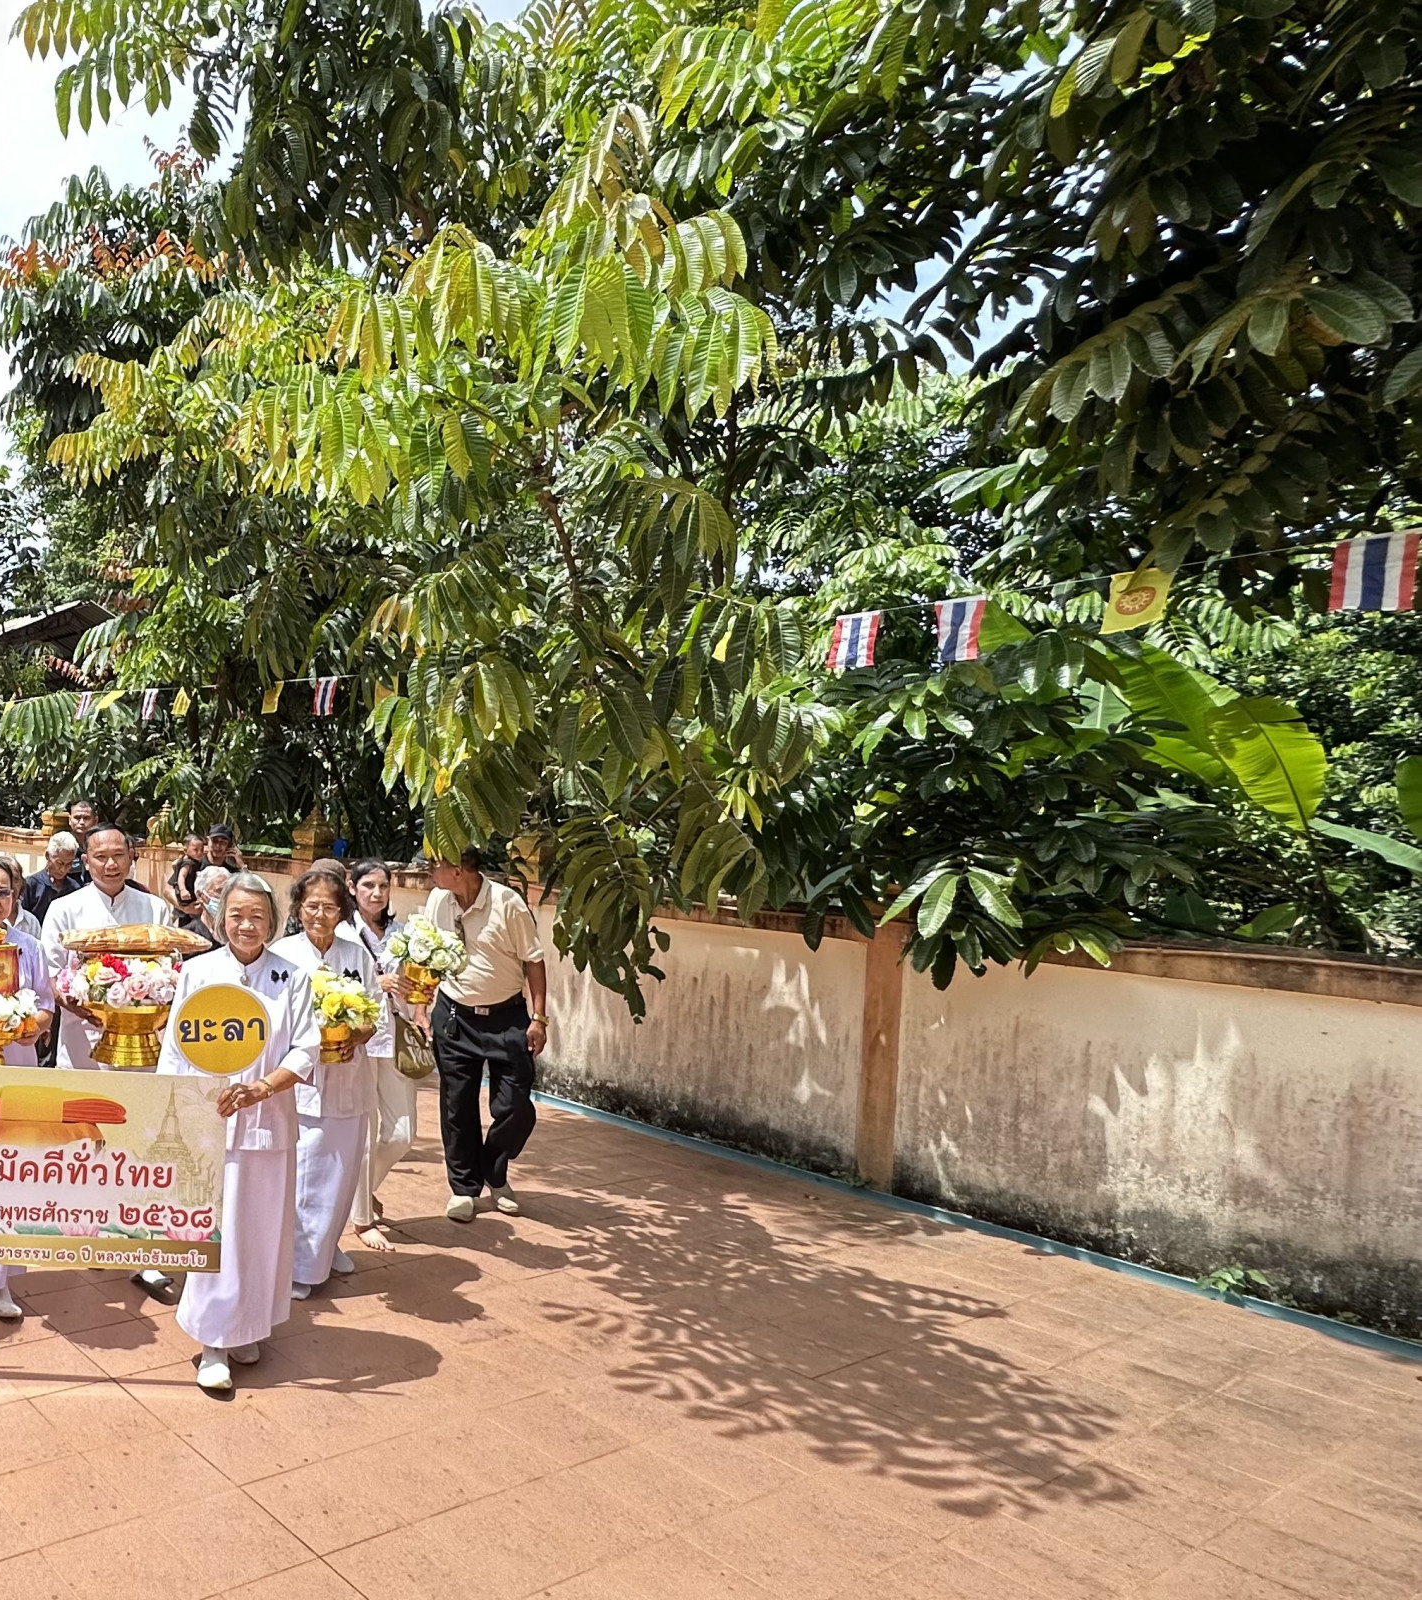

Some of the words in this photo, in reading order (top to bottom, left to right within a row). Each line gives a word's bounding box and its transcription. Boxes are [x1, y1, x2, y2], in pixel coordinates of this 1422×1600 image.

[179, 1017, 265, 1043] ยะลา
[118, 1203, 213, 1229] ๒๕๖๘
[82, 1245, 91, 1260] ปี
[97, 1249, 207, 1266] หลวงพ่อธัมมชโย
